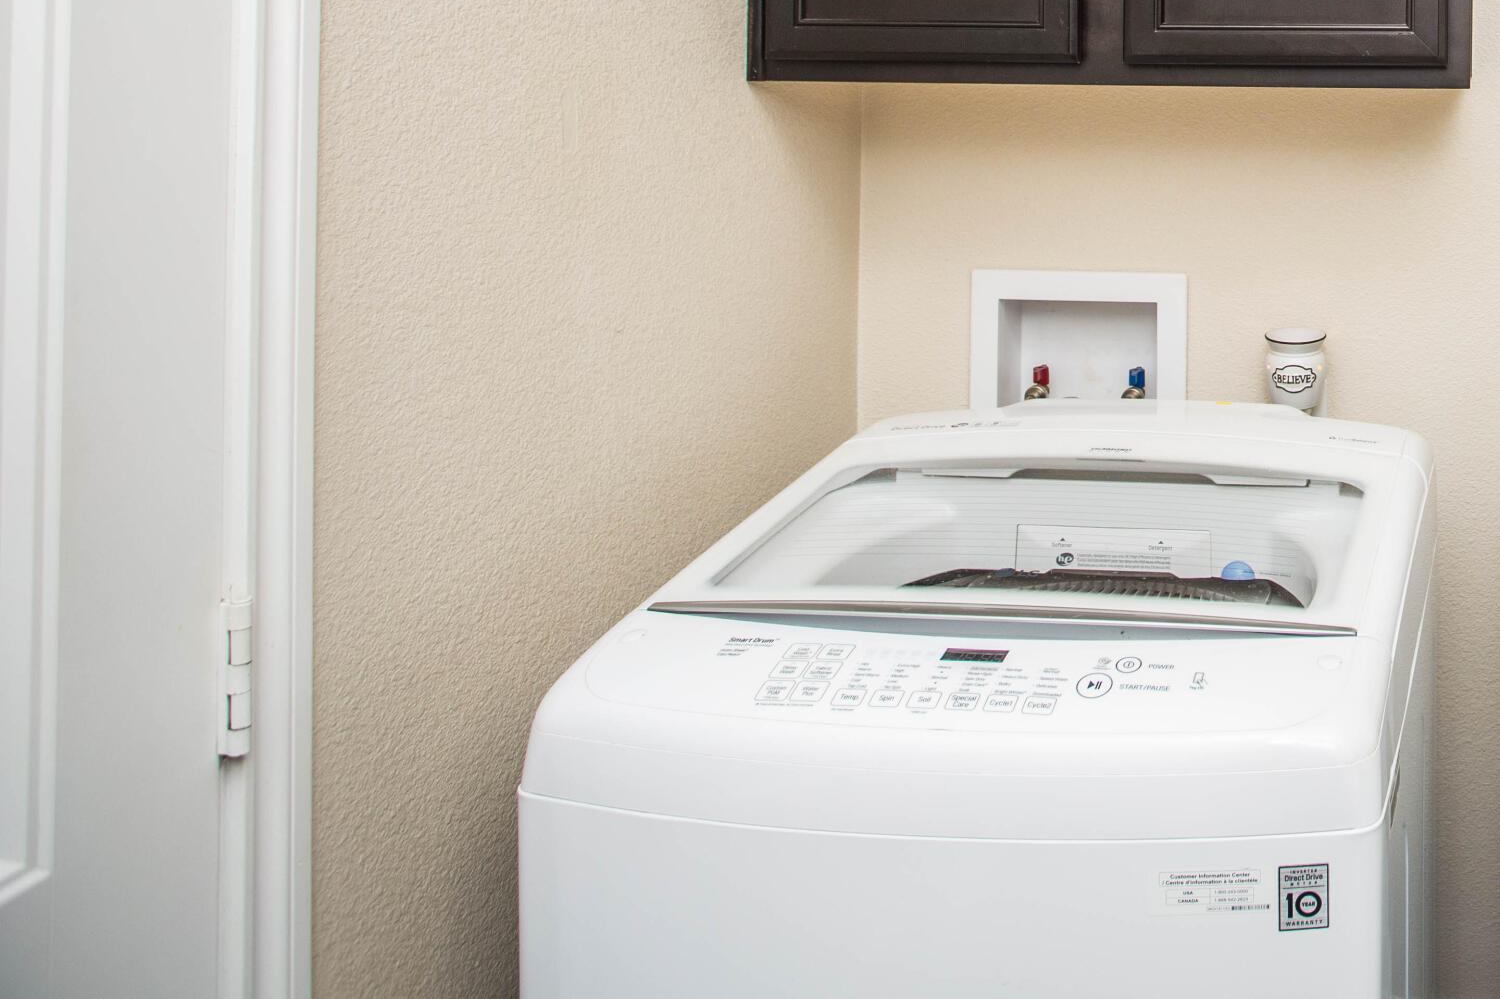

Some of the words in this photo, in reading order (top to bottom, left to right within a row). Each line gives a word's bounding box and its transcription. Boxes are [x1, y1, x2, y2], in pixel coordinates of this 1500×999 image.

[1277, 374, 1311, 384] BELIEVE
[1119, 684, 1170, 692] START/PAUSE
[840, 693, 859, 701] Temp
[879, 694, 895, 702] Spin
[989, 699, 1012, 707] Cycle1
[1027, 701, 1052, 709] Cycle2
[1284, 874, 1304, 882] Direct
[1286, 891, 1322, 918] 10
[1286, 919, 1323, 927] WARRANTY
